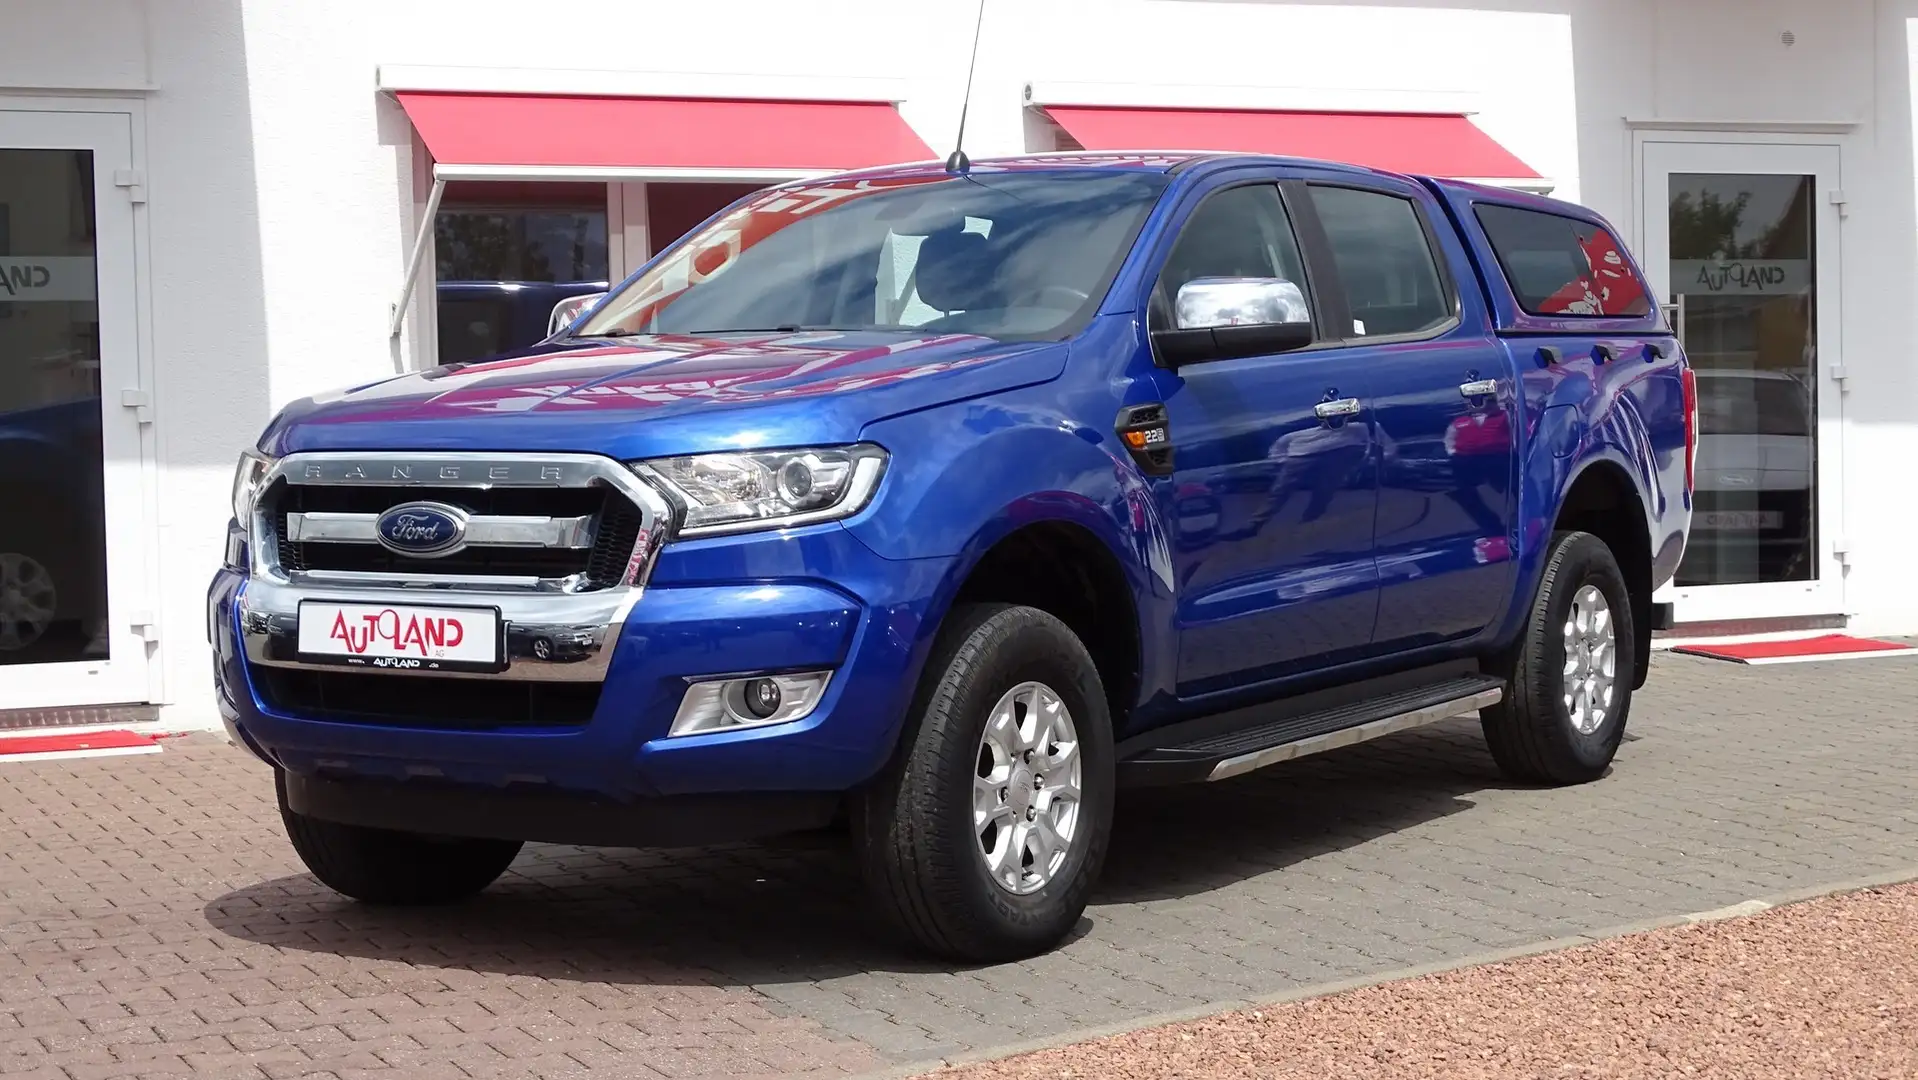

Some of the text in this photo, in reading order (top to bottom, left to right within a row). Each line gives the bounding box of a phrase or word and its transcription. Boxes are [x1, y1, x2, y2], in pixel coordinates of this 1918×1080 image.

[1696, 262, 1785, 291] AUTOLAND
[304, 463, 563, 480] RANGER
[391, 514, 440, 541] Ford
[330, 608, 463, 657] AUTOLAND
[373, 656, 420, 668] AUTOLAND
[434, 650, 445, 658] AG
